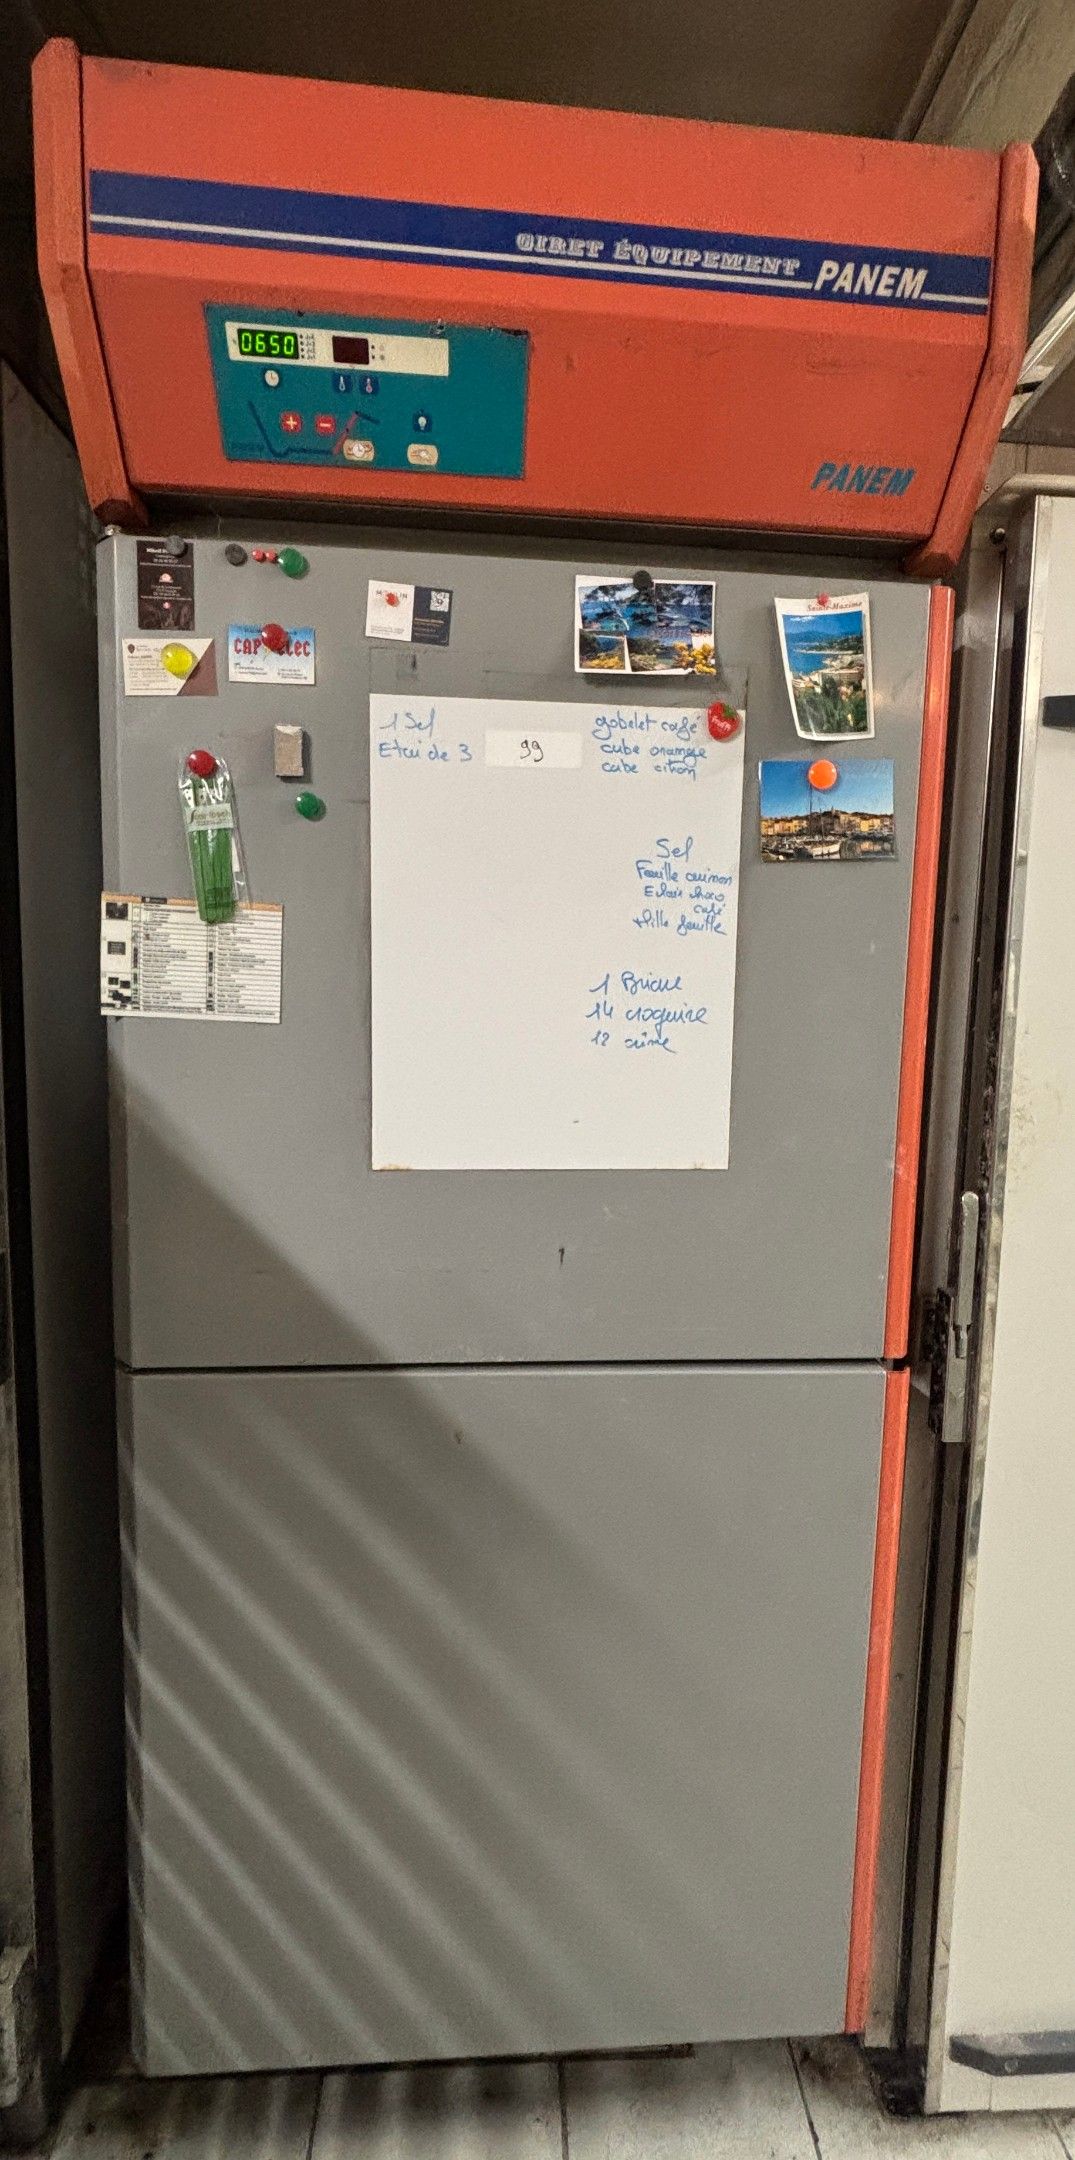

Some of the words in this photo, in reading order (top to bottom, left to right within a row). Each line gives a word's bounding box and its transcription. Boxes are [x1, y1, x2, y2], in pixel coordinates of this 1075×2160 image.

[516, 232, 604, 259] GIRET
[613, 238, 800, 276] ÉQUIPEMENT
[813, 259, 929, 300] PANEM
[241, 332, 295, 355] 0650
[810, 461, 915, 496] PANEM
[404, 707, 436, 738] Sel
[592, 711, 657, 740] gobelet
[661, 715, 701, 741] café
[428, 743, 449, 762] de
[459, 743, 473, 762] 3
[519, 739, 544, 763] 99
[600, 738, 641, 756] cube
[601, 759, 640, 774] cube
[656, 836, 693, 862] Sel
[588, 973, 610, 995] 1
[585, 1000, 614, 1020] 14
